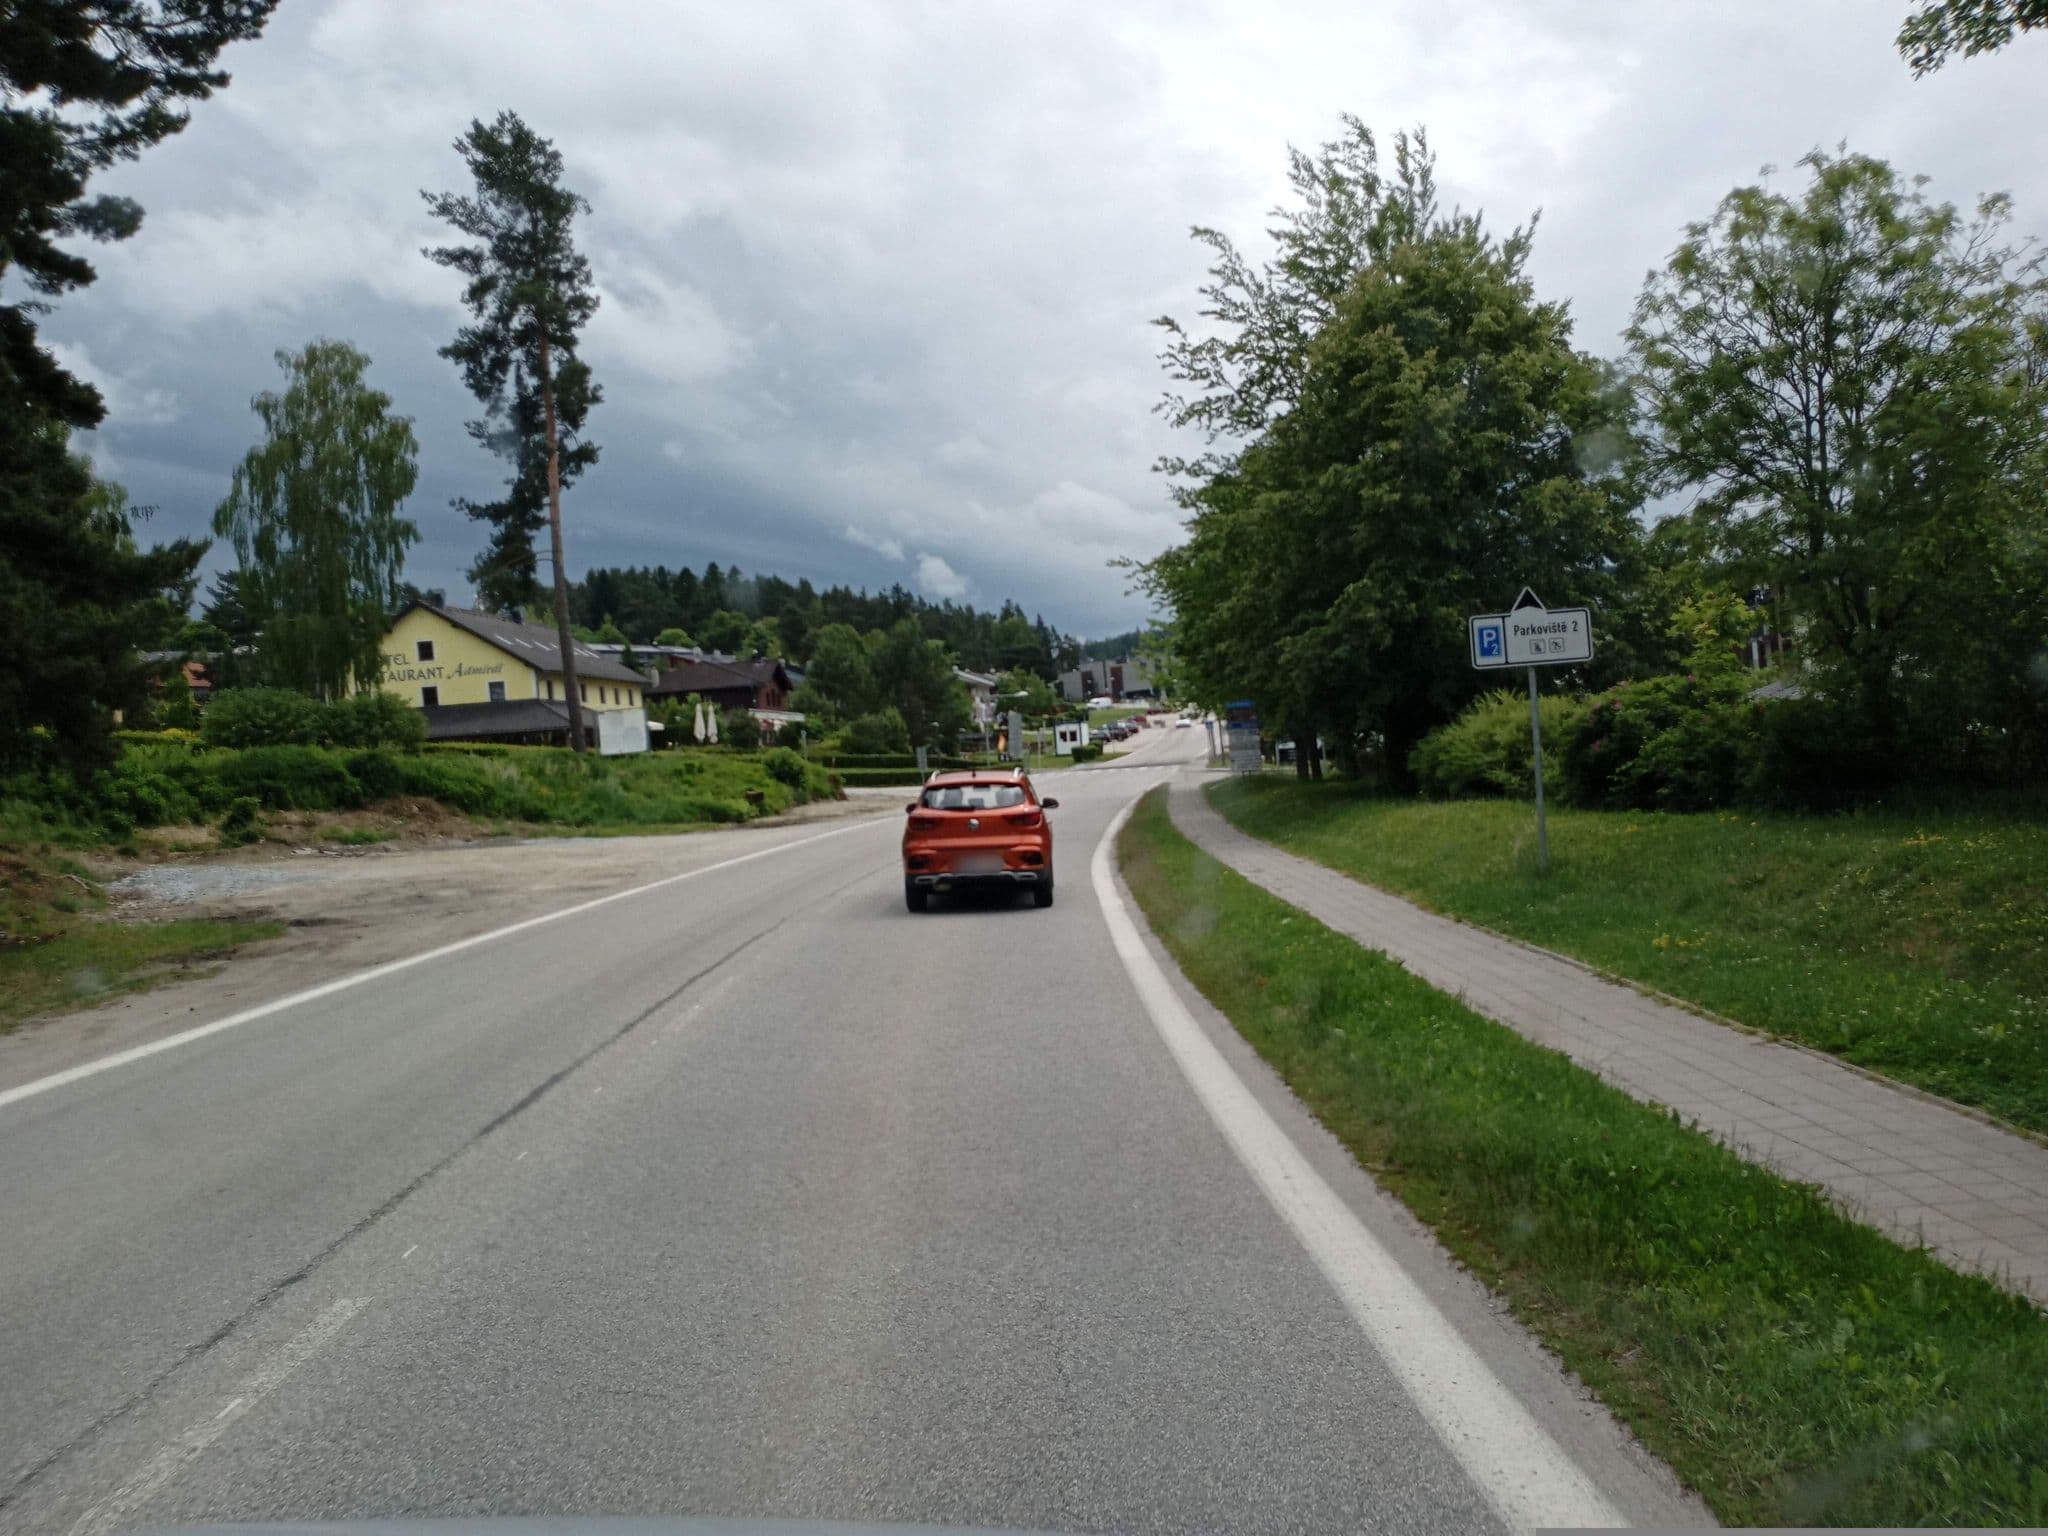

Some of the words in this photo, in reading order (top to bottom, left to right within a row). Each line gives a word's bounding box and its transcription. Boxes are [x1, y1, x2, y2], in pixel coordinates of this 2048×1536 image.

[1513, 621, 1567, 636] Parkoviště
[1572, 620, 1578, 632] 2
[1483, 629, 1496, 648] P
